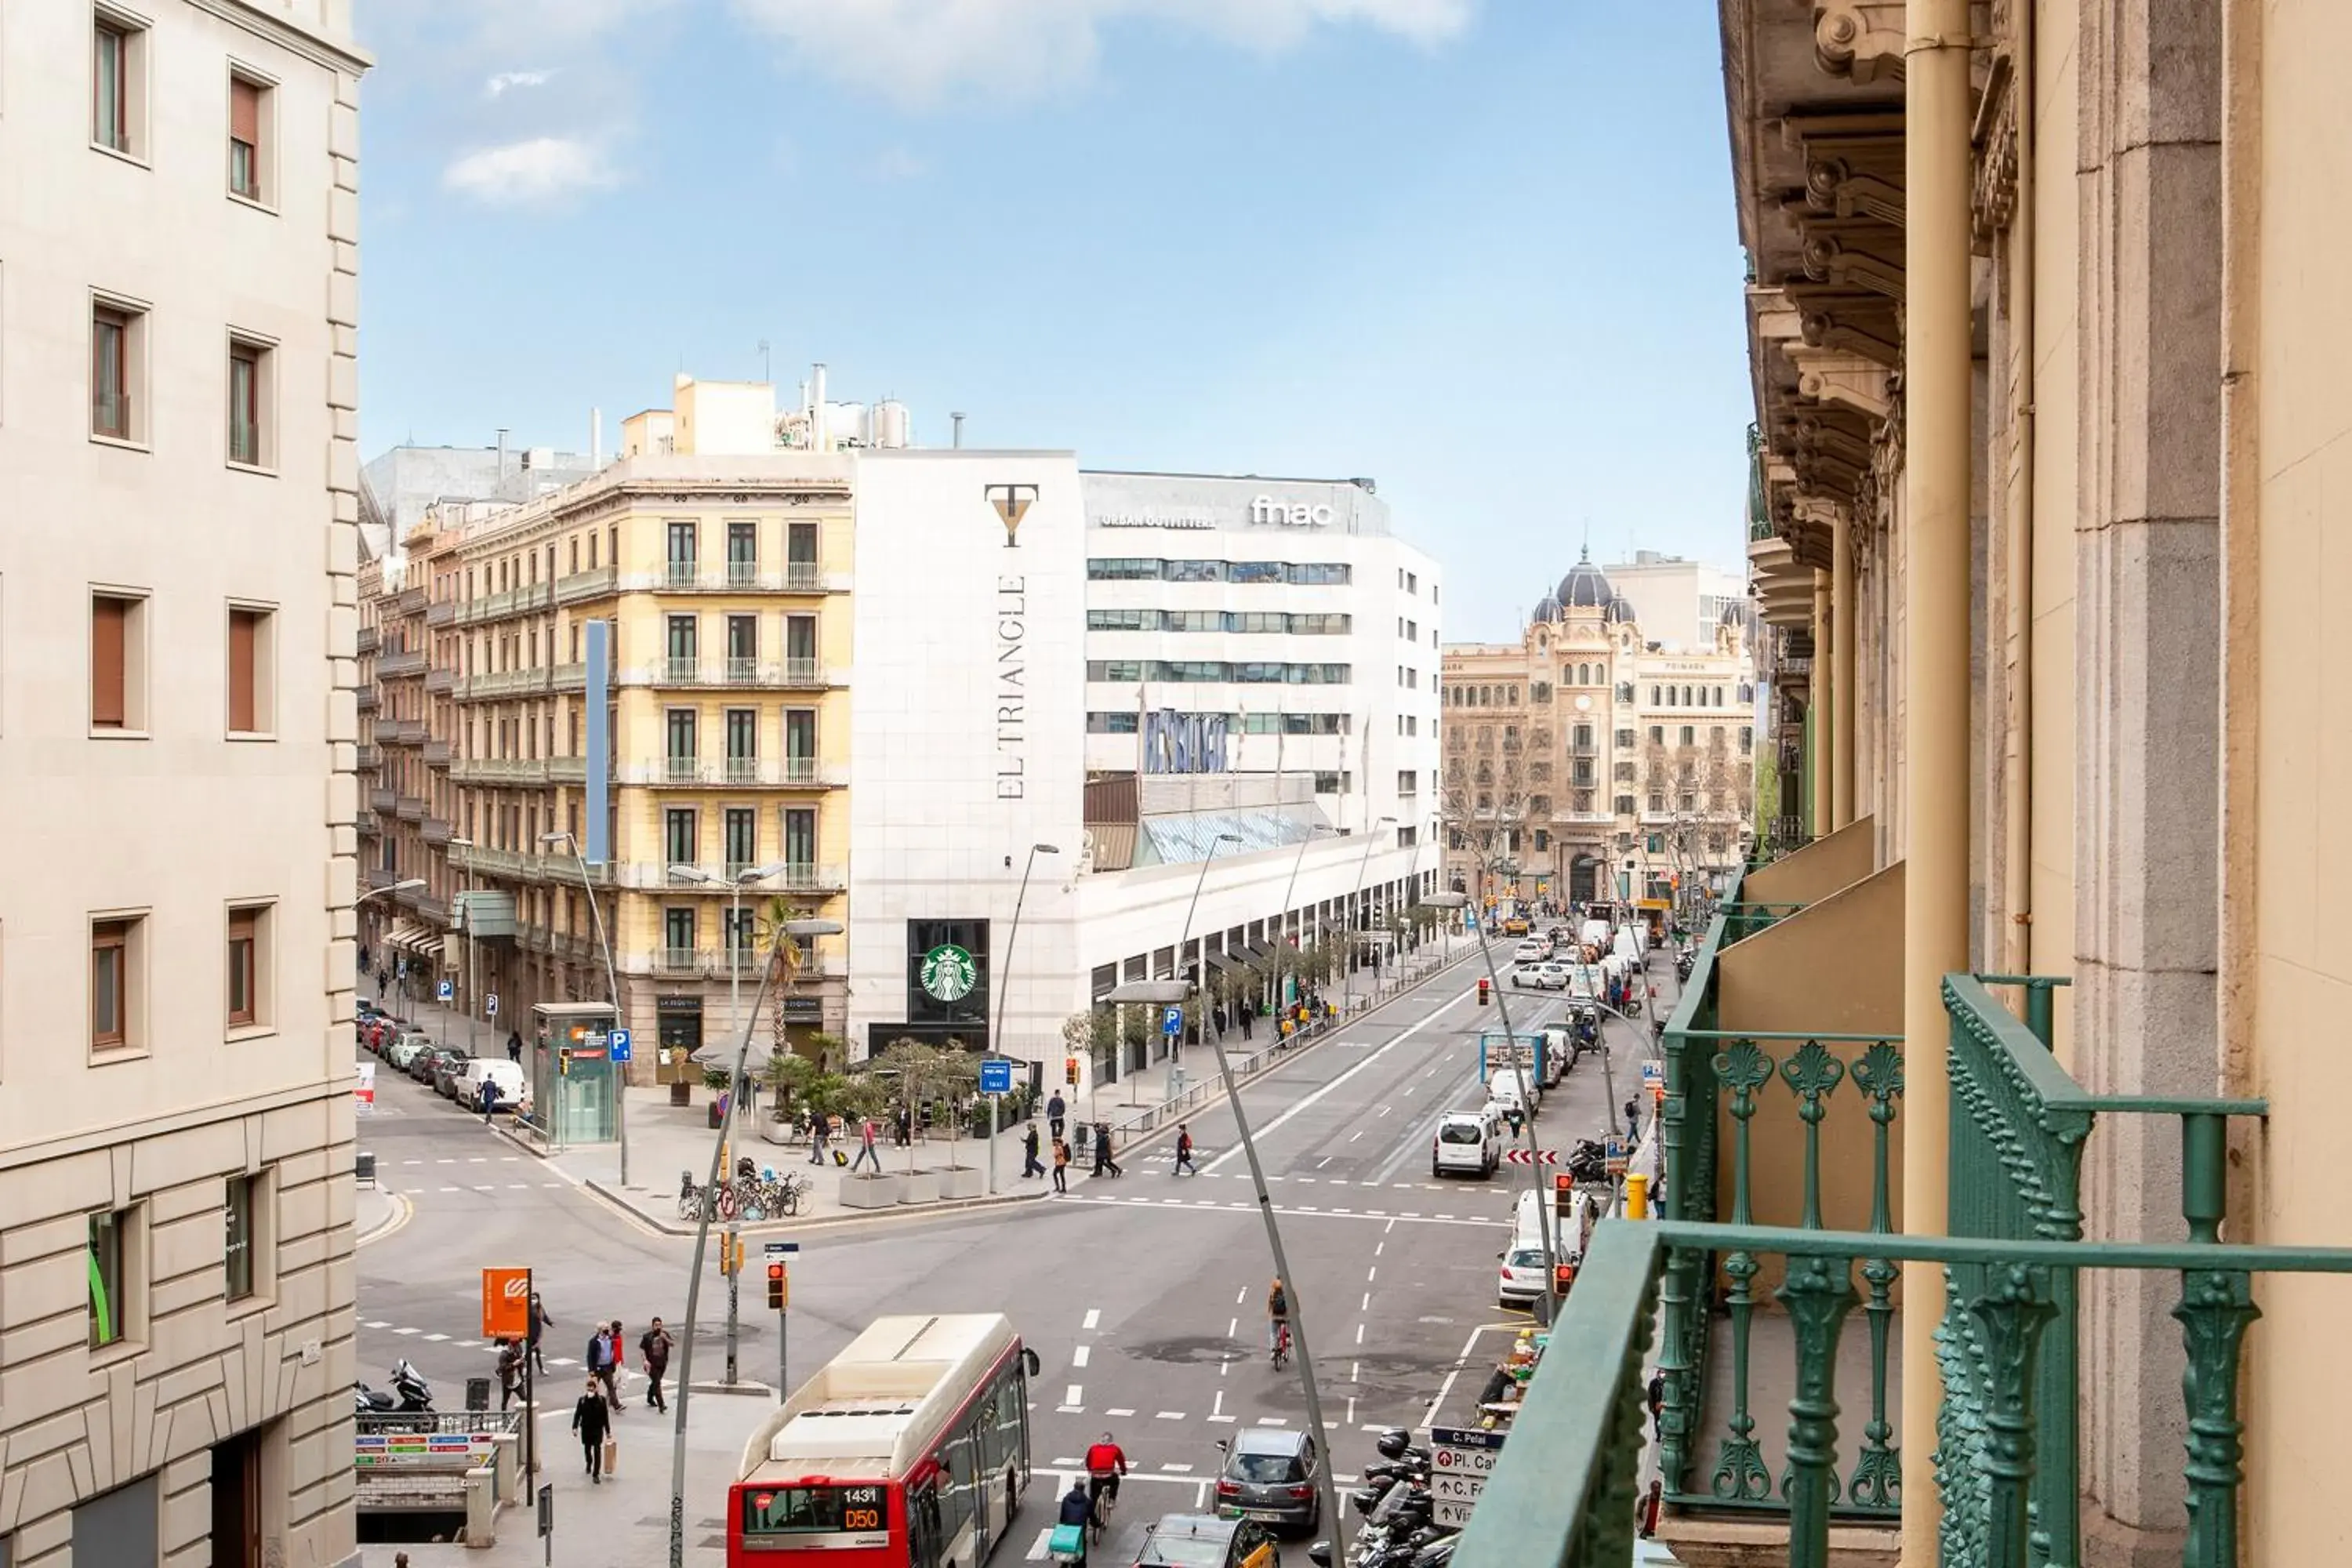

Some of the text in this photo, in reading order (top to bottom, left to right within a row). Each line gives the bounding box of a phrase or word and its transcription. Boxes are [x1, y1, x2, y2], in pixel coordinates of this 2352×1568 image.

[1252, 495, 1333, 524] fnac
[1102, 514, 1144, 526] URBAN
[997, 575, 1025, 799] EL TRIANGLE
[441, 982, 450, 995] P
[488, 996, 495, 1009] P
[1167, 1011, 1178, 1023] P
[612, 1033, 626, 1050] P
[1453, 1432, 1462, 1442] C.
[1454, 1454, 1470, 1468] Pl.
[1454, 1481, 1467, 1495] C.
[844, 1489, 877, 1503] 1431
[845, 1509, 879, 1529] D50
